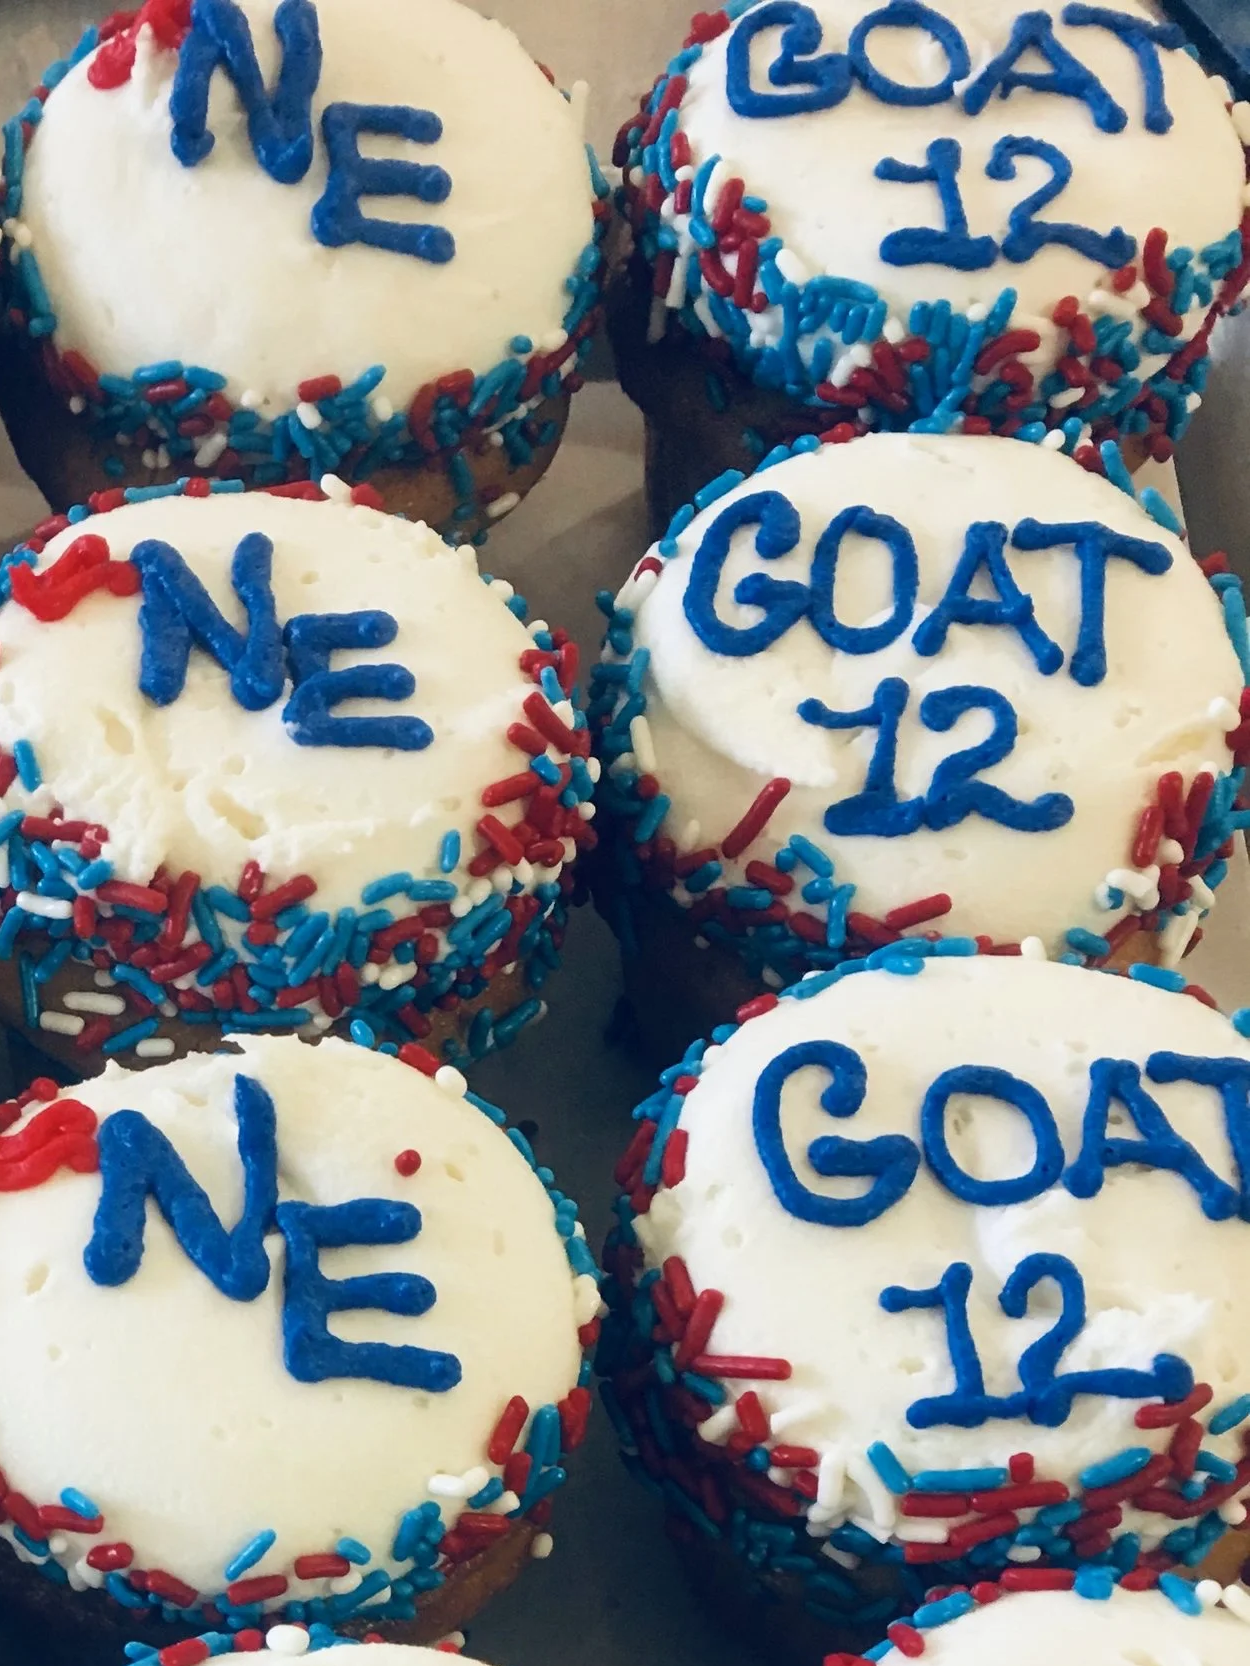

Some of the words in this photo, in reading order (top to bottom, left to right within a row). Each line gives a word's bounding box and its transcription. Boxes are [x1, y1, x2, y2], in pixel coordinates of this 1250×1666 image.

[170, 0, 455, 264] NE
[726, 0, 1190, 134] GOAT
[874, 135, 1137, 270] 12
[130, 532, 435, 751] NE
[682, 490, 1174, 687] GOAT
[797, 677, 1075, 838] 12
[752, 1040, 1250, 1228] GOAT
[83, 1073, 462, 1392] NE
[879, 1252, 1194, 1430] 12
